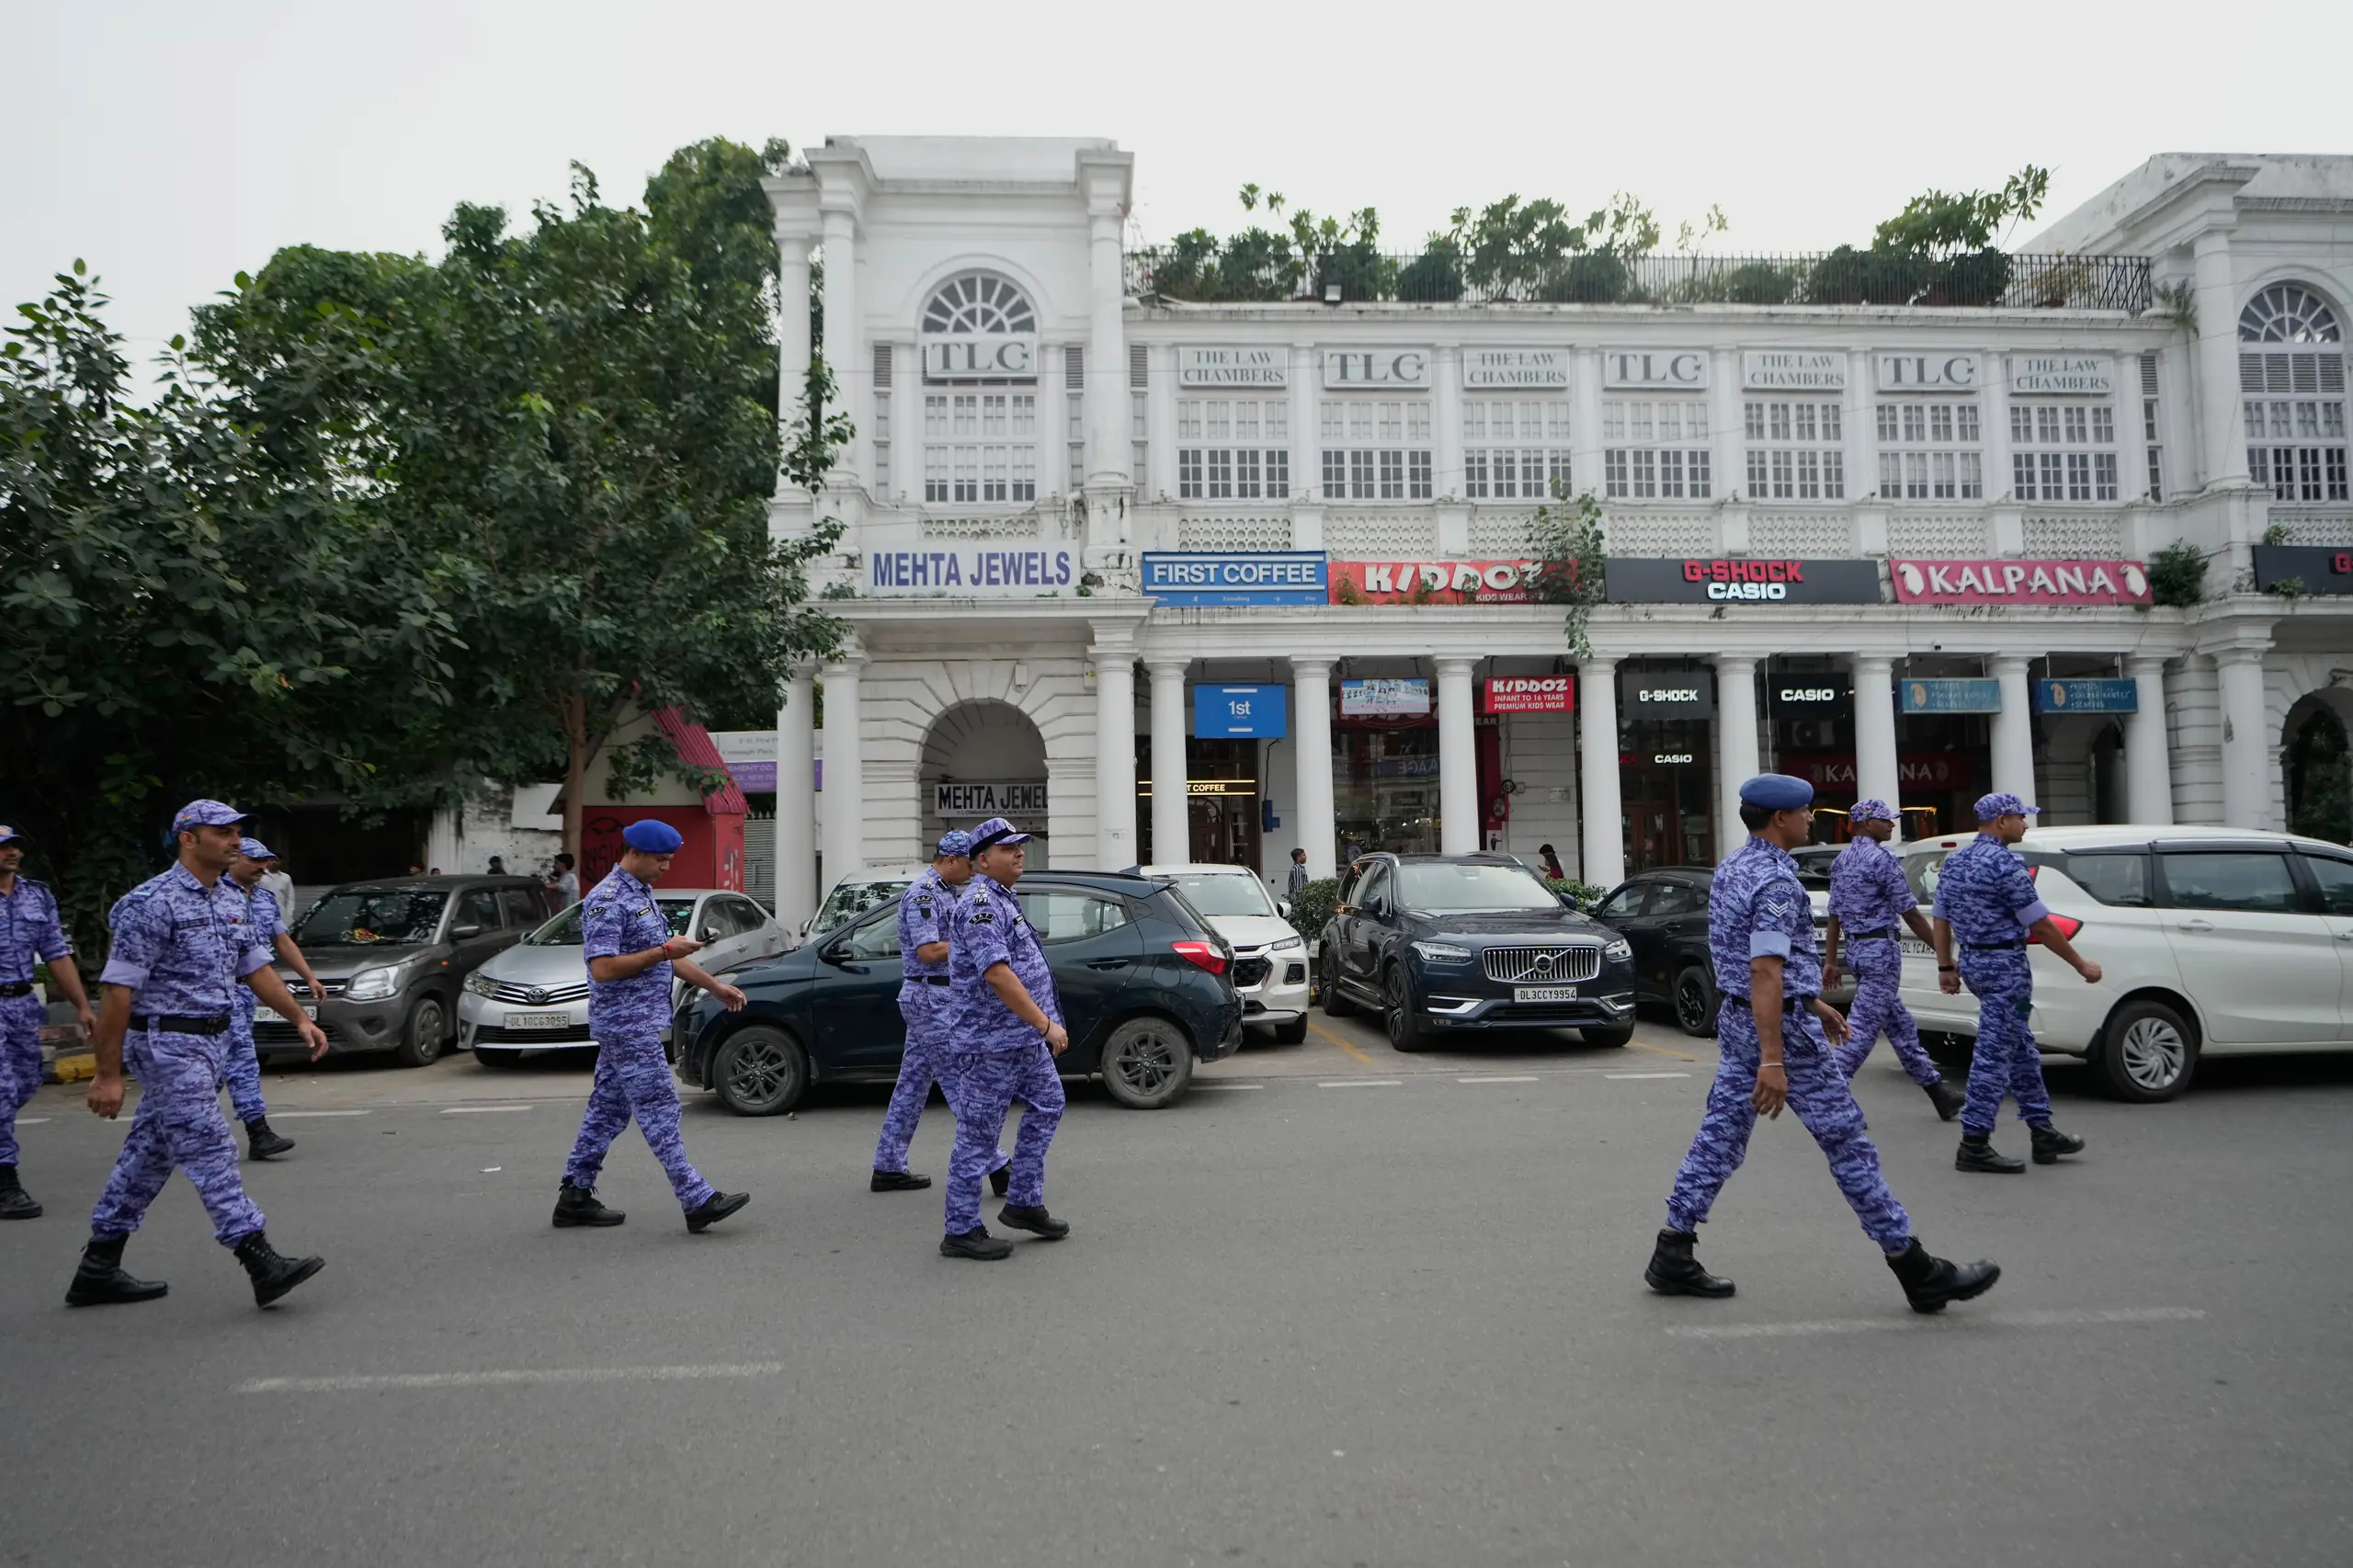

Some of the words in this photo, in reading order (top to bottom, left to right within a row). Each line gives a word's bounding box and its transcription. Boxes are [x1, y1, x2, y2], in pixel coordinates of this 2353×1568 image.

[931, 342, 1029, 371] TLC
[1193, 350, 1230, 364] THE
[1234, 350, 1274, 364] LAW
[1478, 353, 1513, 367] THE
[1519, 353, 1557, 367] LAW
[1758, 355, 1793, 368] THE
[1799, 355, 1835, 368] LAW
[1330, 353, 1425, 381] TLC
[1609, 354, 1702, 382] TLC
[1884, 357, 1974, 385] TLC
[2026, 359, 2059, 372] THE
[2063, 359, 2099, 372] LAW
[1184, 369, 1284, 382] CHAMBERS
[1470, 370, 1566, 384] CHAMBERS
[1751, 372, 1845, 386] CHAMBERS
[2016, 377, 2109, 391] CHAMBERS
[873, 552, 961, 586] MEHTA
[970, 551, 1071, 586] JEWELS
[1154, 563, 1220, 584] FIRST
[1223, 563, 1316, 584] COFFEE
[1684, 560, 1804, 582] G-SHOCK
[1927, 564, 2118, 596] KALPANA
[1475, 594, 1498, 602] KIDS
[1499, 593, 1527, 601] WEAR
[1707, 582, 1787, 599] CASIO
[1492, 678, 1568, 693] KIDDOZ
[1639, 689, 1699, 702] G-SHOCK
[1780, 689, 1835, 701] CASIO
[1228, 700, 1251, 715] 1st
[1494, 702, 1526, 710] PREMIUM
[1654, 754, 1692, 764] CASIO
[1825, 763, 1933, 782] KANA
[1192, 784, 1225, 792] COFFEE
[939, 786, 996, 809] MEHTA
[1000, 785, 1049, 809] JEWEL
[1519, 989, 1576, 1000] DL3CCY9954
[510, 1016, 567, 1028] DL10CG3095
